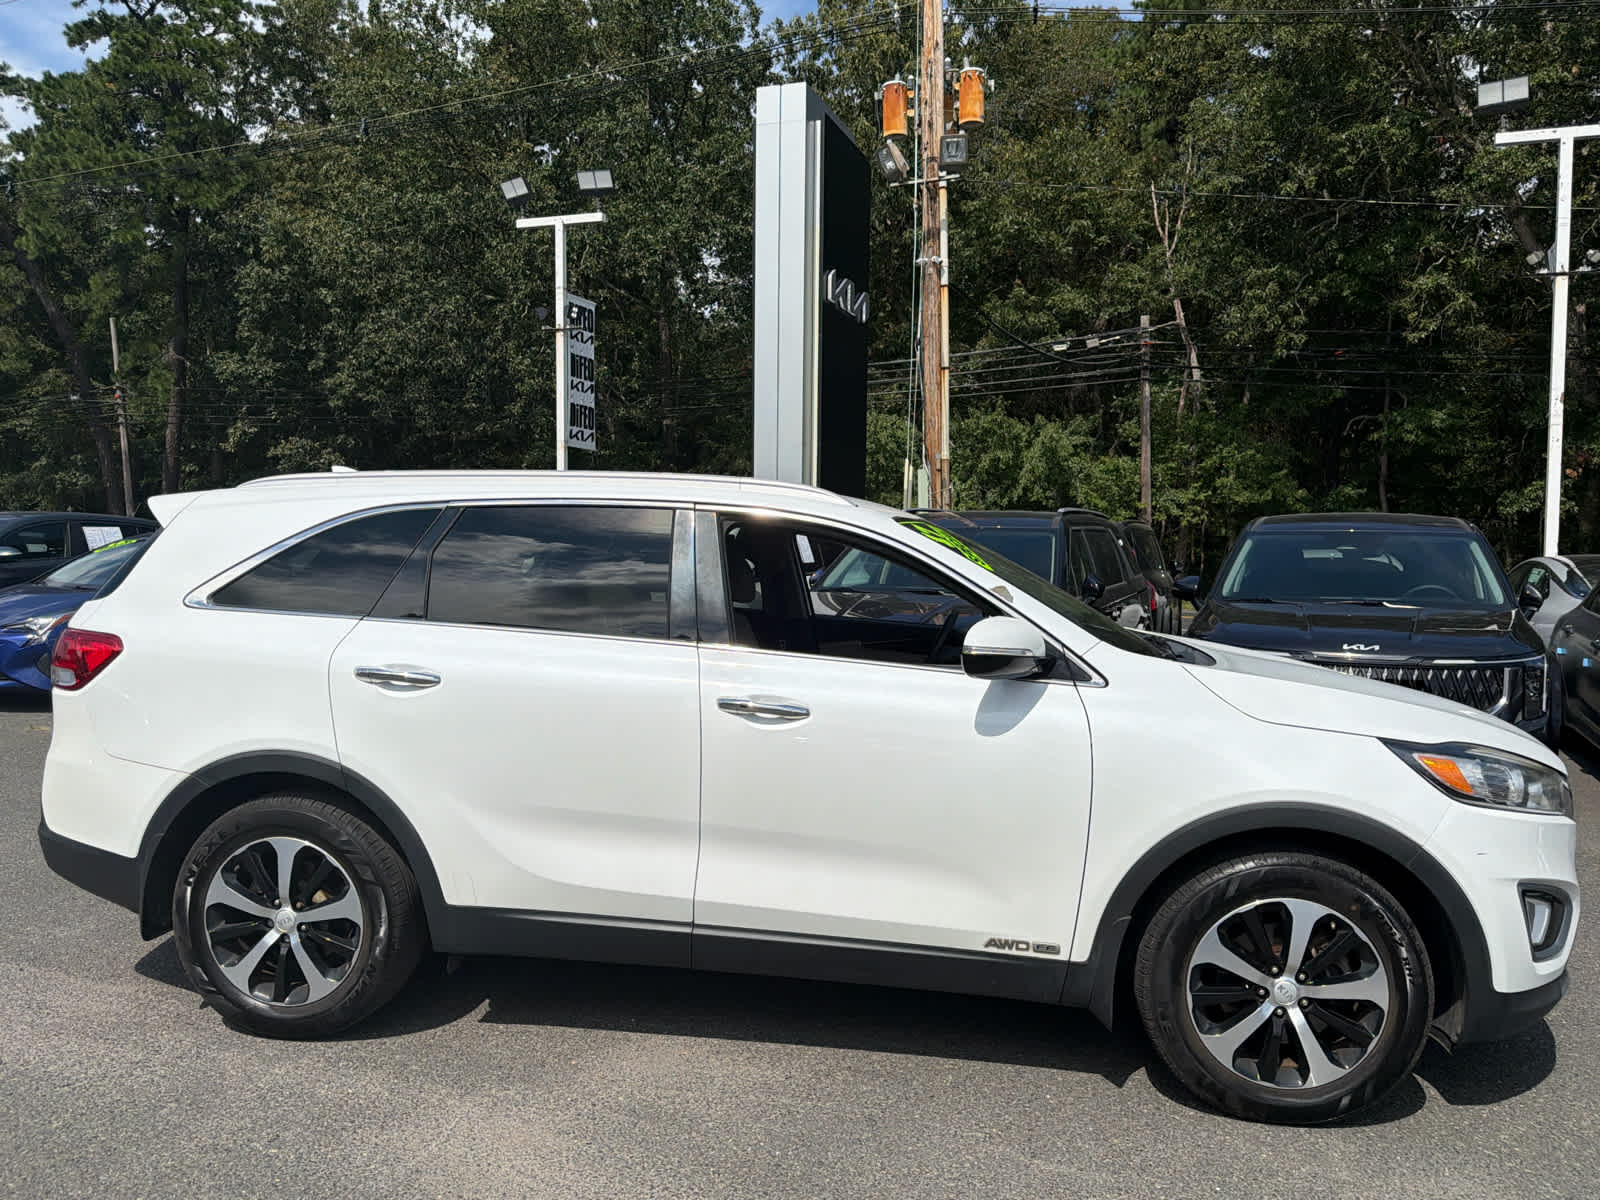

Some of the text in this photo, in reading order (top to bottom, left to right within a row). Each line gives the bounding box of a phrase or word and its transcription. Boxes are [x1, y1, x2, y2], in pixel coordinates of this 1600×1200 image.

[570, 329, 594, 345] KIA
[570, 379, 594, 395] KIA
[569, 428, 595, 443] KIA
[984, 936, 1030, 952] AWD
